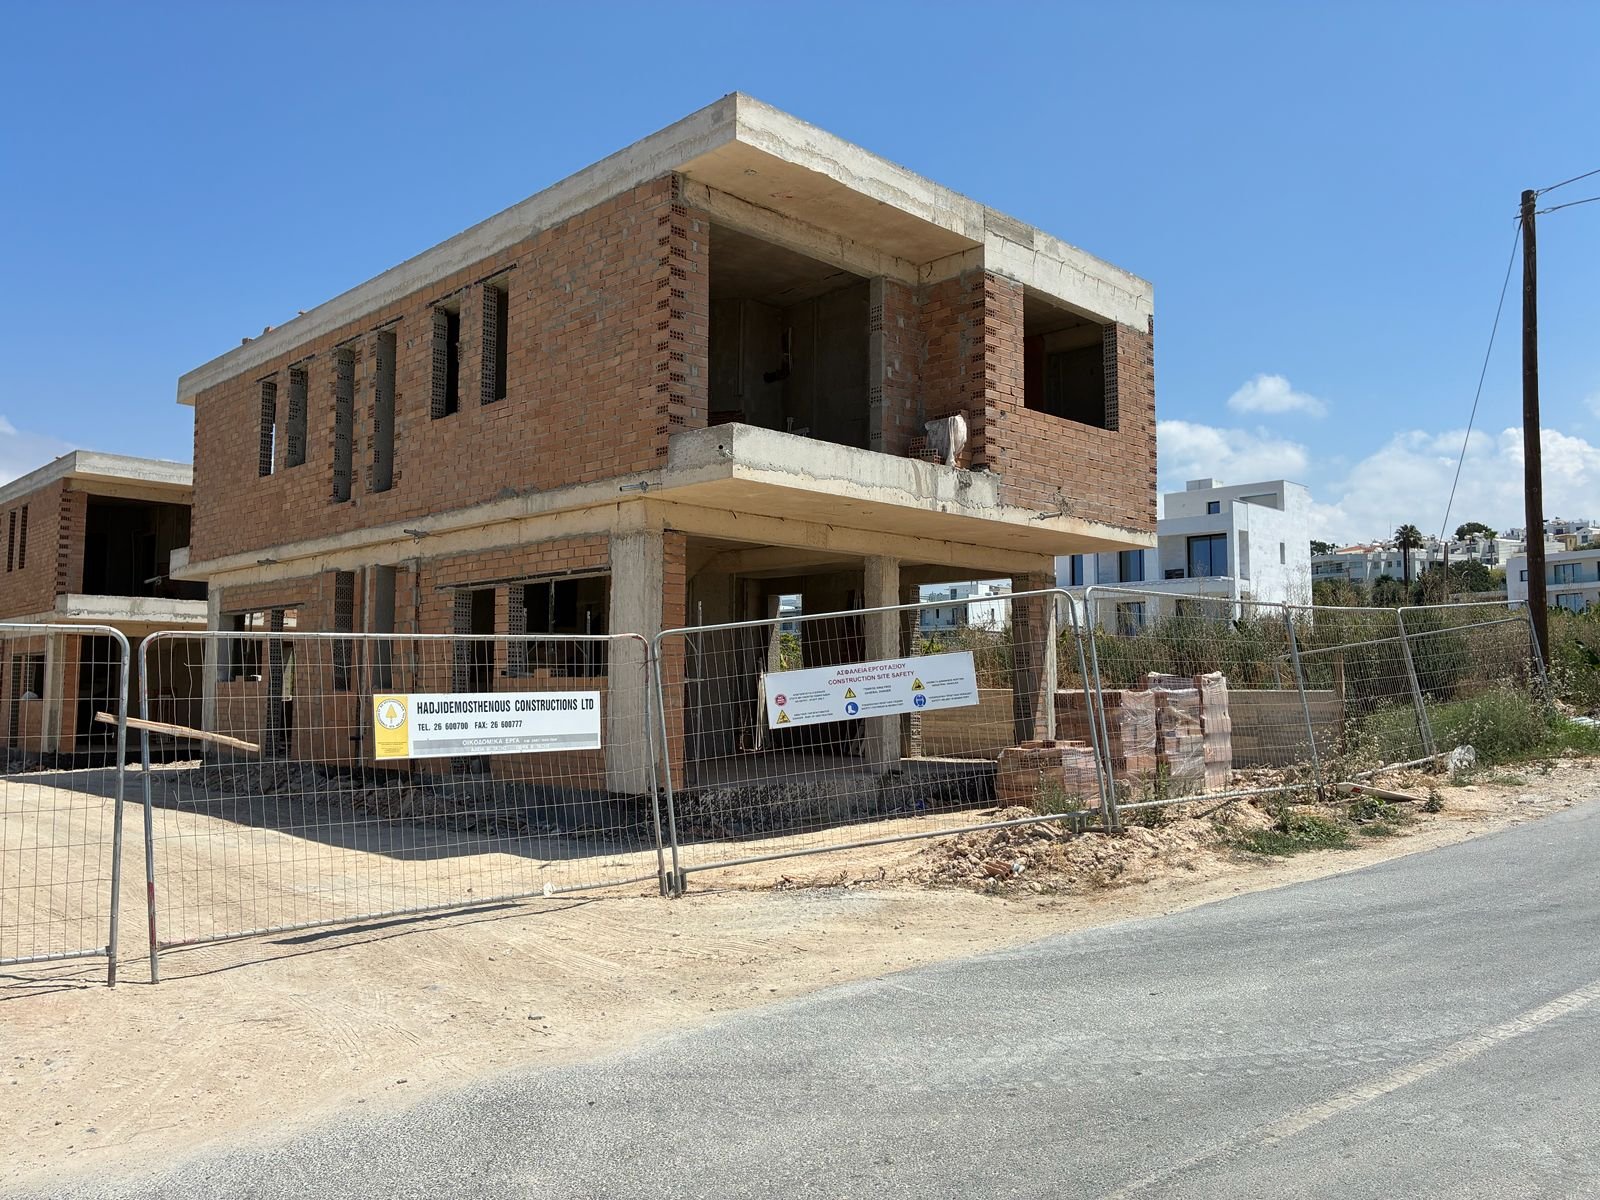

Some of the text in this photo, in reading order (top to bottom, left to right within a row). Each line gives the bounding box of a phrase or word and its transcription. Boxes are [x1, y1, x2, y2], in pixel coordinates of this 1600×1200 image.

[836, 663, 906, 676] ΑΣΦΑΛΕΙΑ ΕΡΓΟΤΑΞΙΟΥ
[828, 670, 915, 686] CONSTRUCTION SITE SAFETY
[416, 699, 511, 714] HADJIDEMOSTHENOUS
[515, 698, 578, 712] CONSTRUCTIONS
[581, 698, 594, 710] LTD
[418, 723, 431, 731] TEL.
[433, 723, 442, 731] 26
[444, 722, 469, 730] 600700
[474, 721, 488, 729] FAX:
[500, 720, 523, 729] 600777
